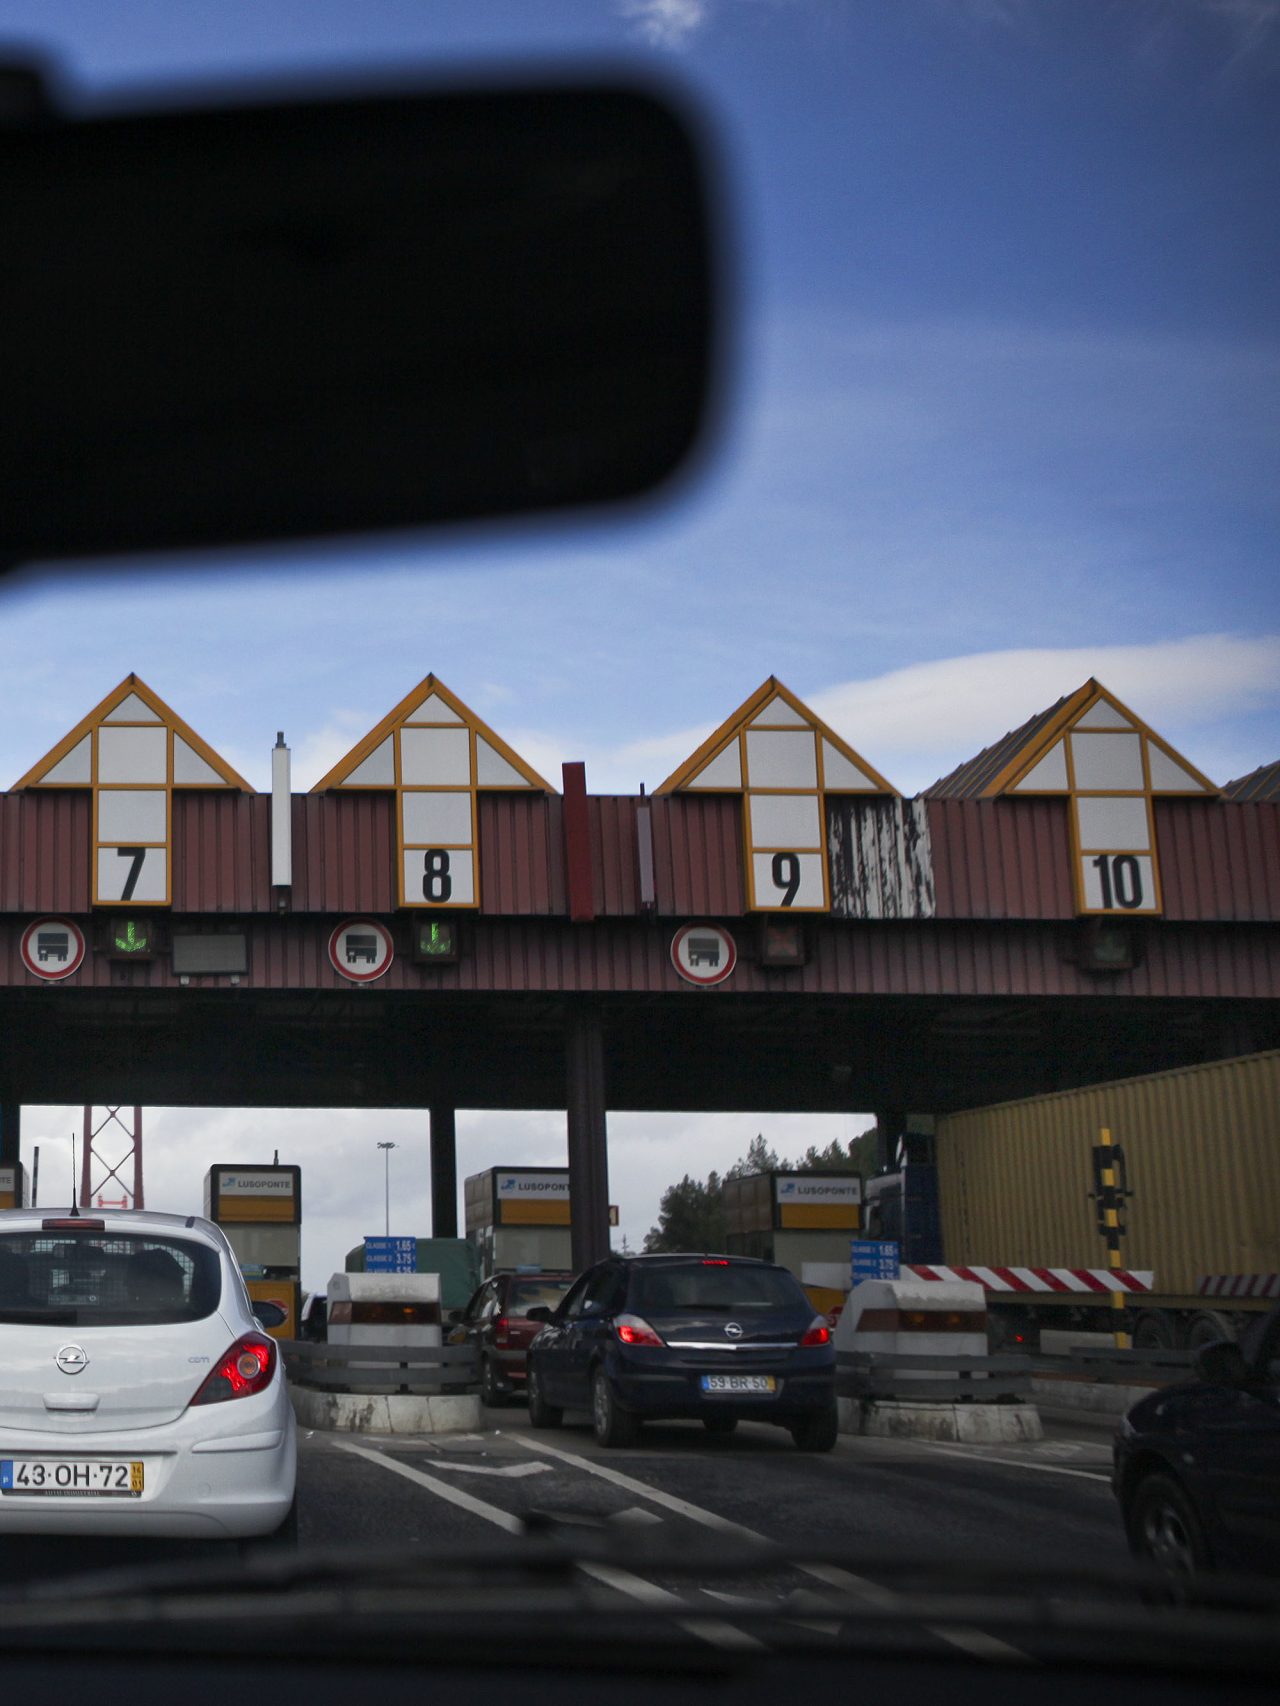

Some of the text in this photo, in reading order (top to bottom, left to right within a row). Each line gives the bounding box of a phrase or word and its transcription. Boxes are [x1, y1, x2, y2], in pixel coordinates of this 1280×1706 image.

[117, 847, 146, 900] 7
[423, 848, 451, 903] 8
[772, 852, 800, 907] 9
[1093, 855, 1143, 909] 10
[518, 1183, 570, 1191] LUSOPONT
[798, 1186, 858, 1195] LUSOPONTE
[396, 1253, 412, 1264] 3.75
[397, 1240, 412, 1251] 1.65
